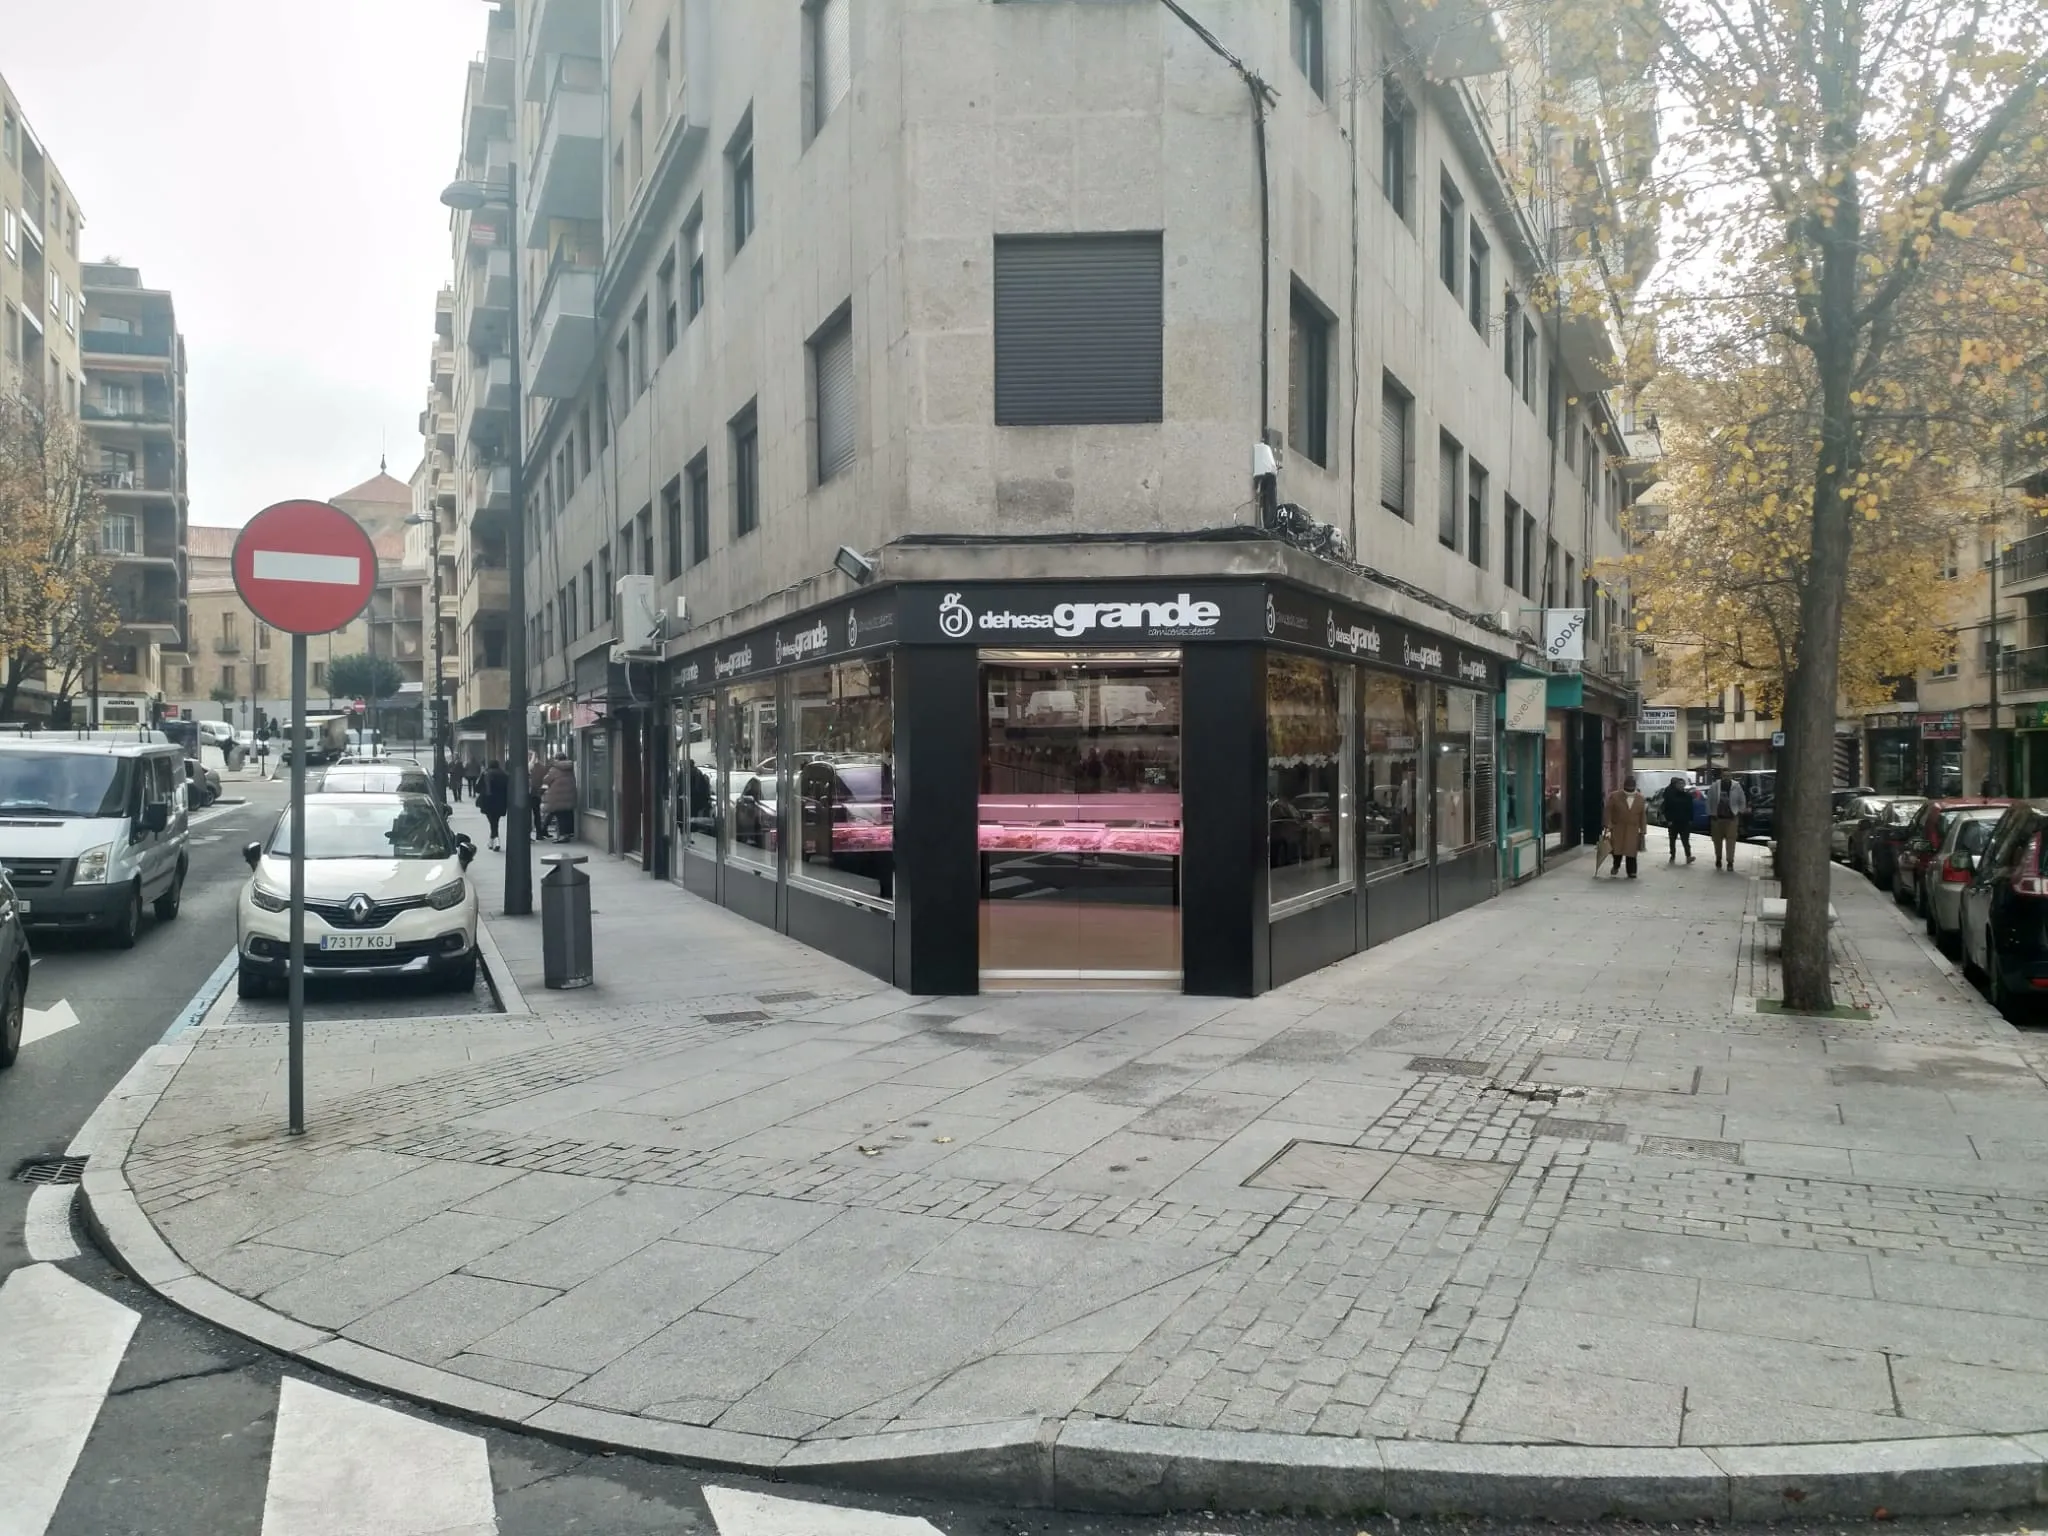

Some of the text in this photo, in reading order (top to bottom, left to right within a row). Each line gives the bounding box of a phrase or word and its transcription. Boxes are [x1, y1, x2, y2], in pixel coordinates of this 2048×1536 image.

[979, 594, 1221, 637] dehesa grande
[795, 620, 828, 660] grande
[1350, 625, 1380, 654] grande
[1548, 614, 1585, 656] BODAS
[1420, 645, 1442, 669] grande
[330, 935, 393, 949] 7317 KGJ
